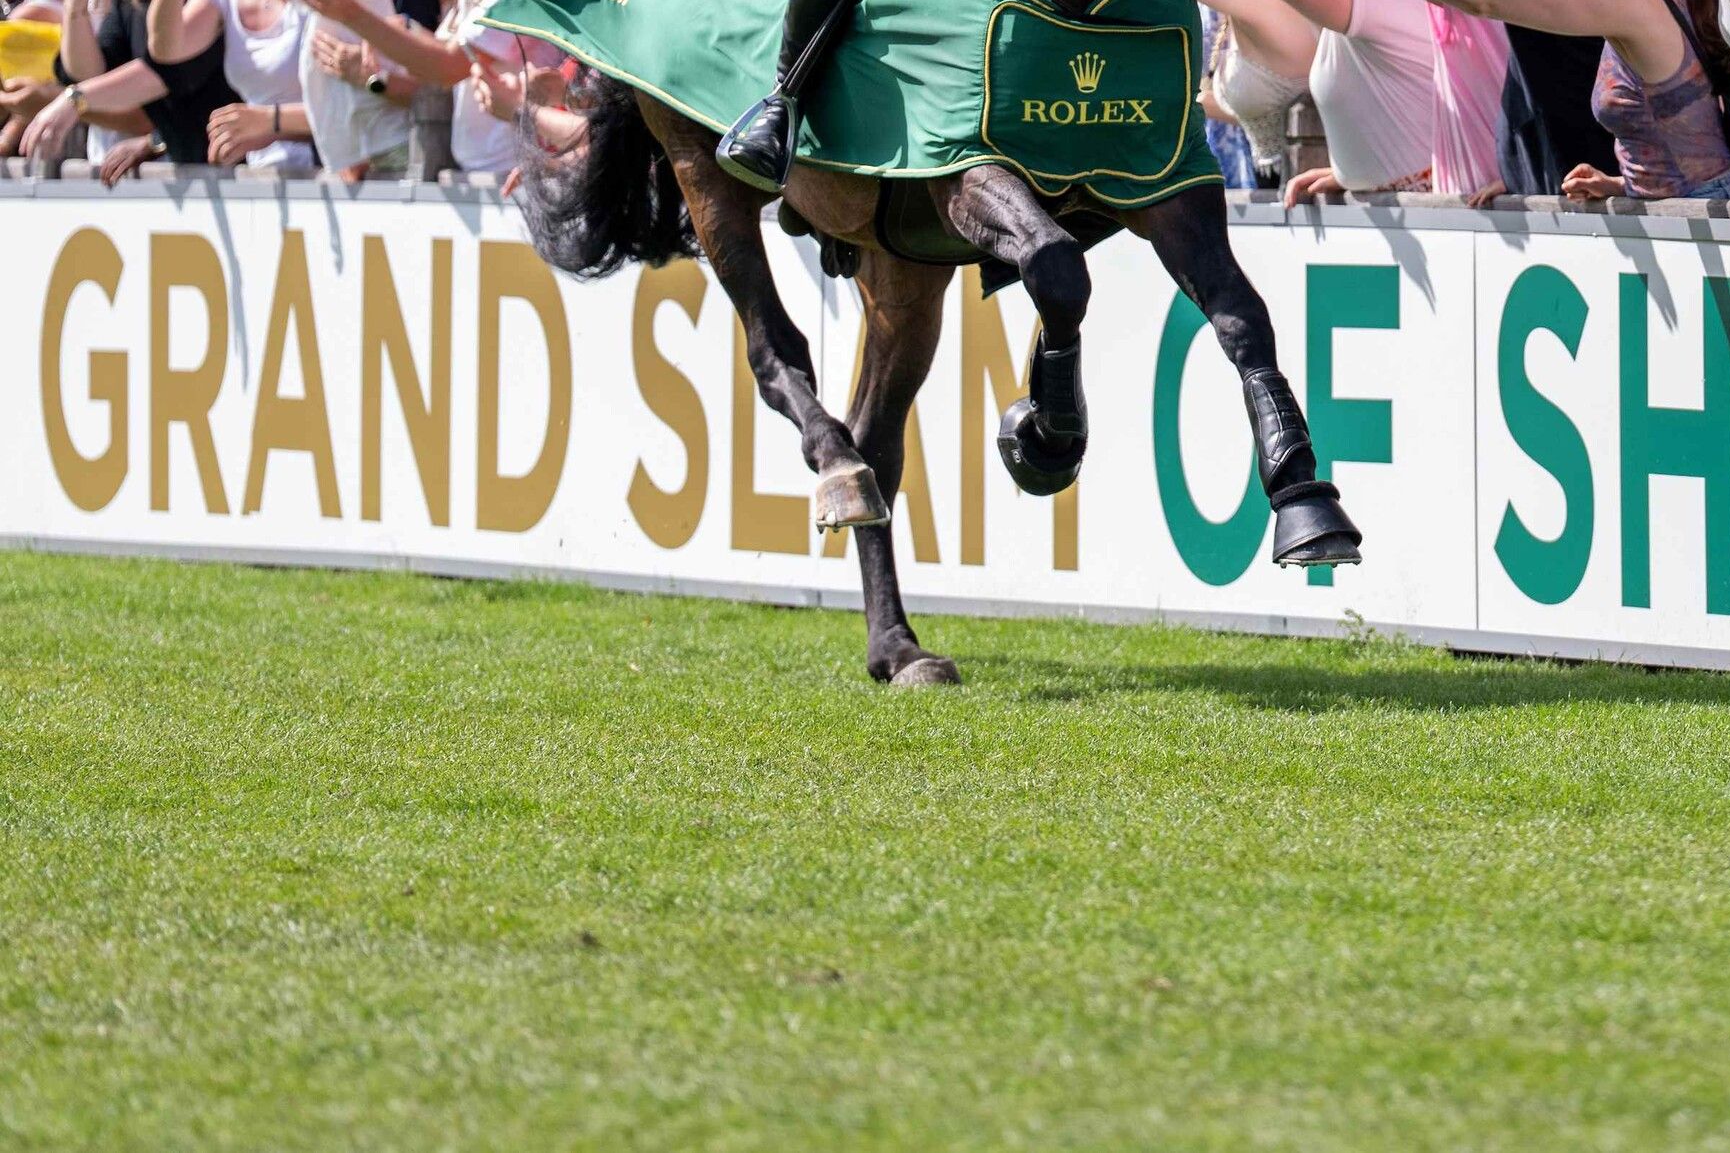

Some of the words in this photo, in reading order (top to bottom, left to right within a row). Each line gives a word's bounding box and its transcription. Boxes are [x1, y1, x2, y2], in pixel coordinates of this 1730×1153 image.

[1021, 99, 1153, 125] ROLEX
[41, 226, 572, 532] GRAND
[1153, 264, 1400, 587] OF
